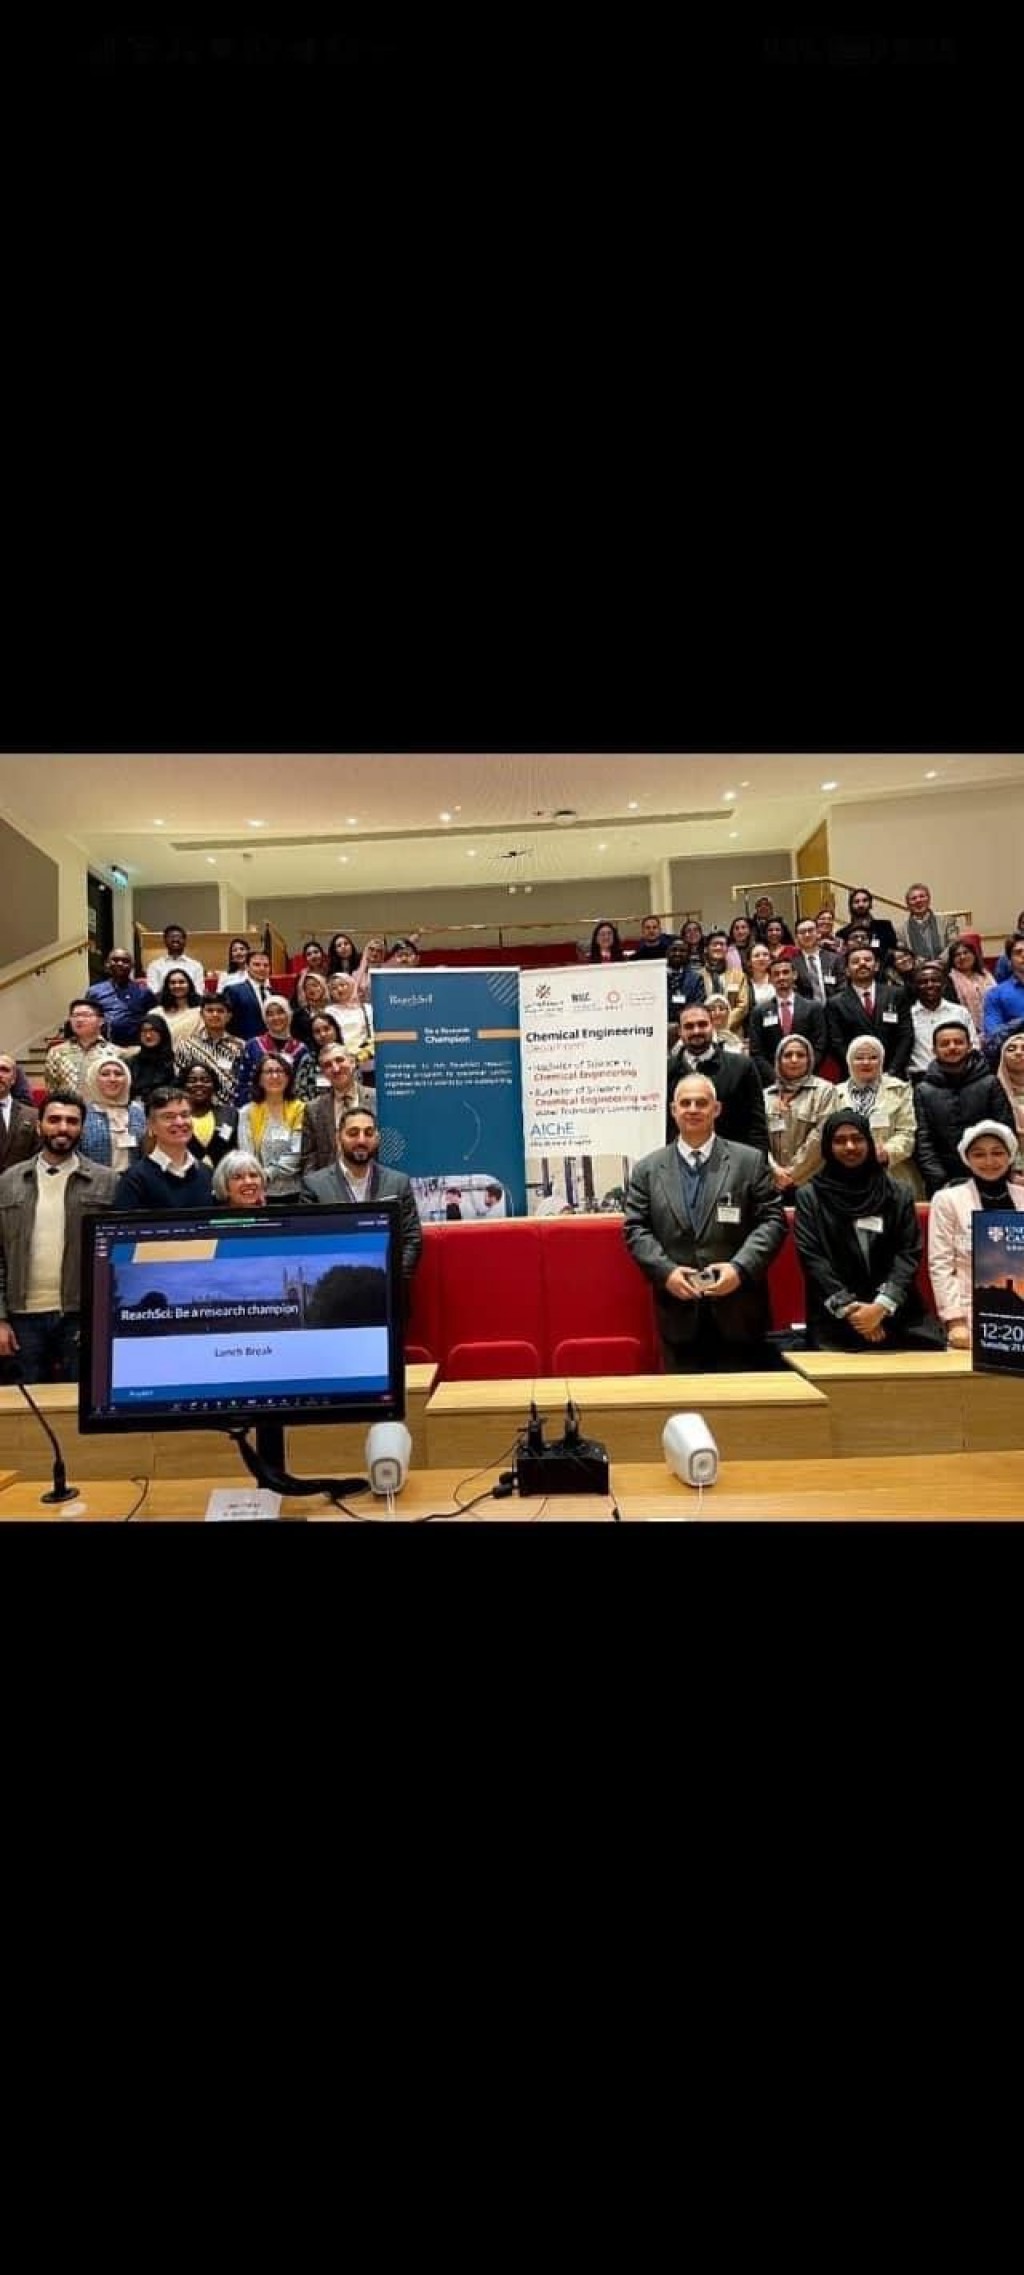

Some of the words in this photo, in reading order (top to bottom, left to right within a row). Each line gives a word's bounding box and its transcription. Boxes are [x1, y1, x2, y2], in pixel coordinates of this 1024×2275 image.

[424, 1035, 471, 1045] Champion
[525, 1030, 580, 1043] Chemical
[582, 1025, 654, 1040] Engineering
[533, 1071, 577, 1081] Chemical
[578, 1067, 638, 1080] Engineering
[535, 1096, 578, 1106] Chemical
[579, 1093, 638, 1105] Engineering
[530, 1121, 575, 1138] AIChE
[175, 1307, 191, 1319] Be
[199, 1304, 246, 1318] research
[246, 1301, 299, 1317] champion
[979, 1322, 1024, 1342] 12:20
[214, 1344, 244, 1358] Lunch
[245, 1343, 273, 1357] Break
